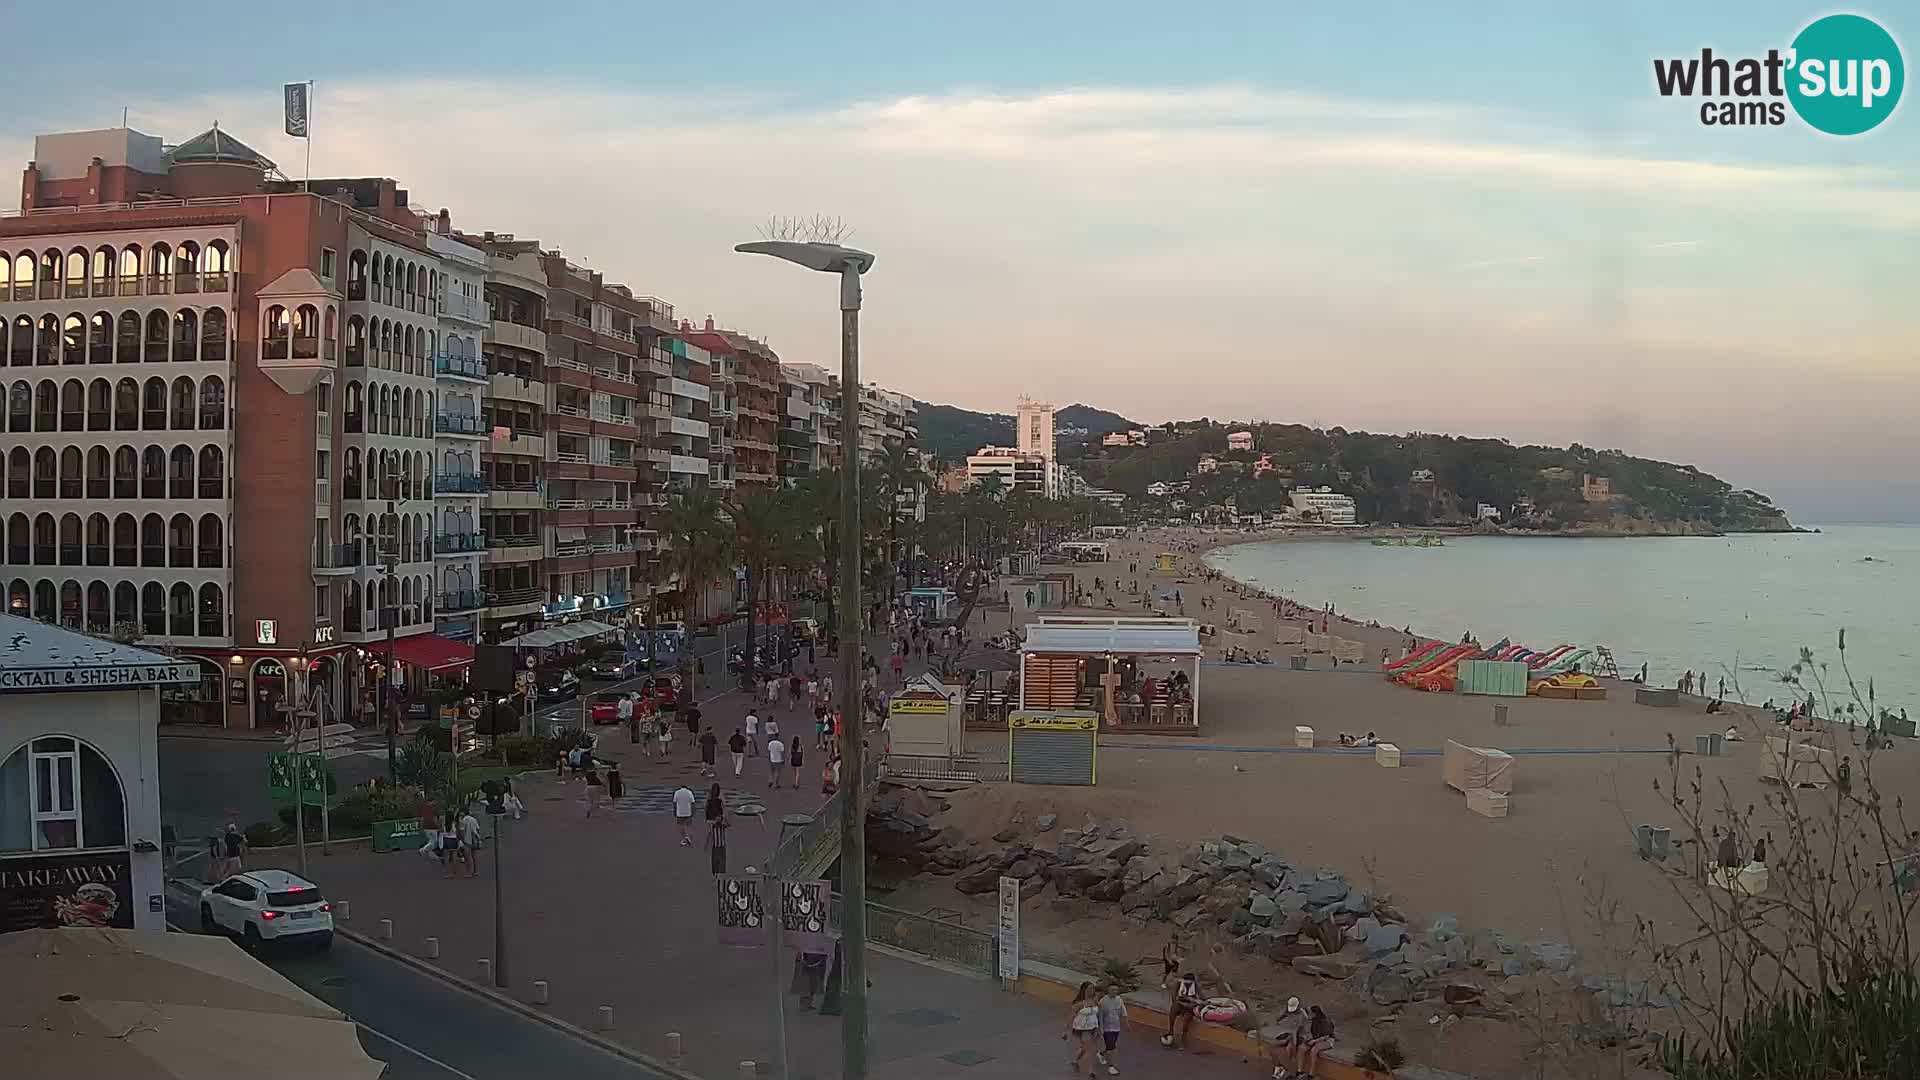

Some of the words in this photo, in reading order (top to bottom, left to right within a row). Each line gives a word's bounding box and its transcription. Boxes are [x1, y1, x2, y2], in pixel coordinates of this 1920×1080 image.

[315, 626, 334, 643] KFC
[0, 671, 60, 687] CKTAIL
[64, 671, 76, 685] &
[80, 669, 142, 685] SHISHA
[148, 667, 180, 681] BAR
[259, 665, 283, 675] KFC
[0, 864, 122, 889] TAKEAWAY
